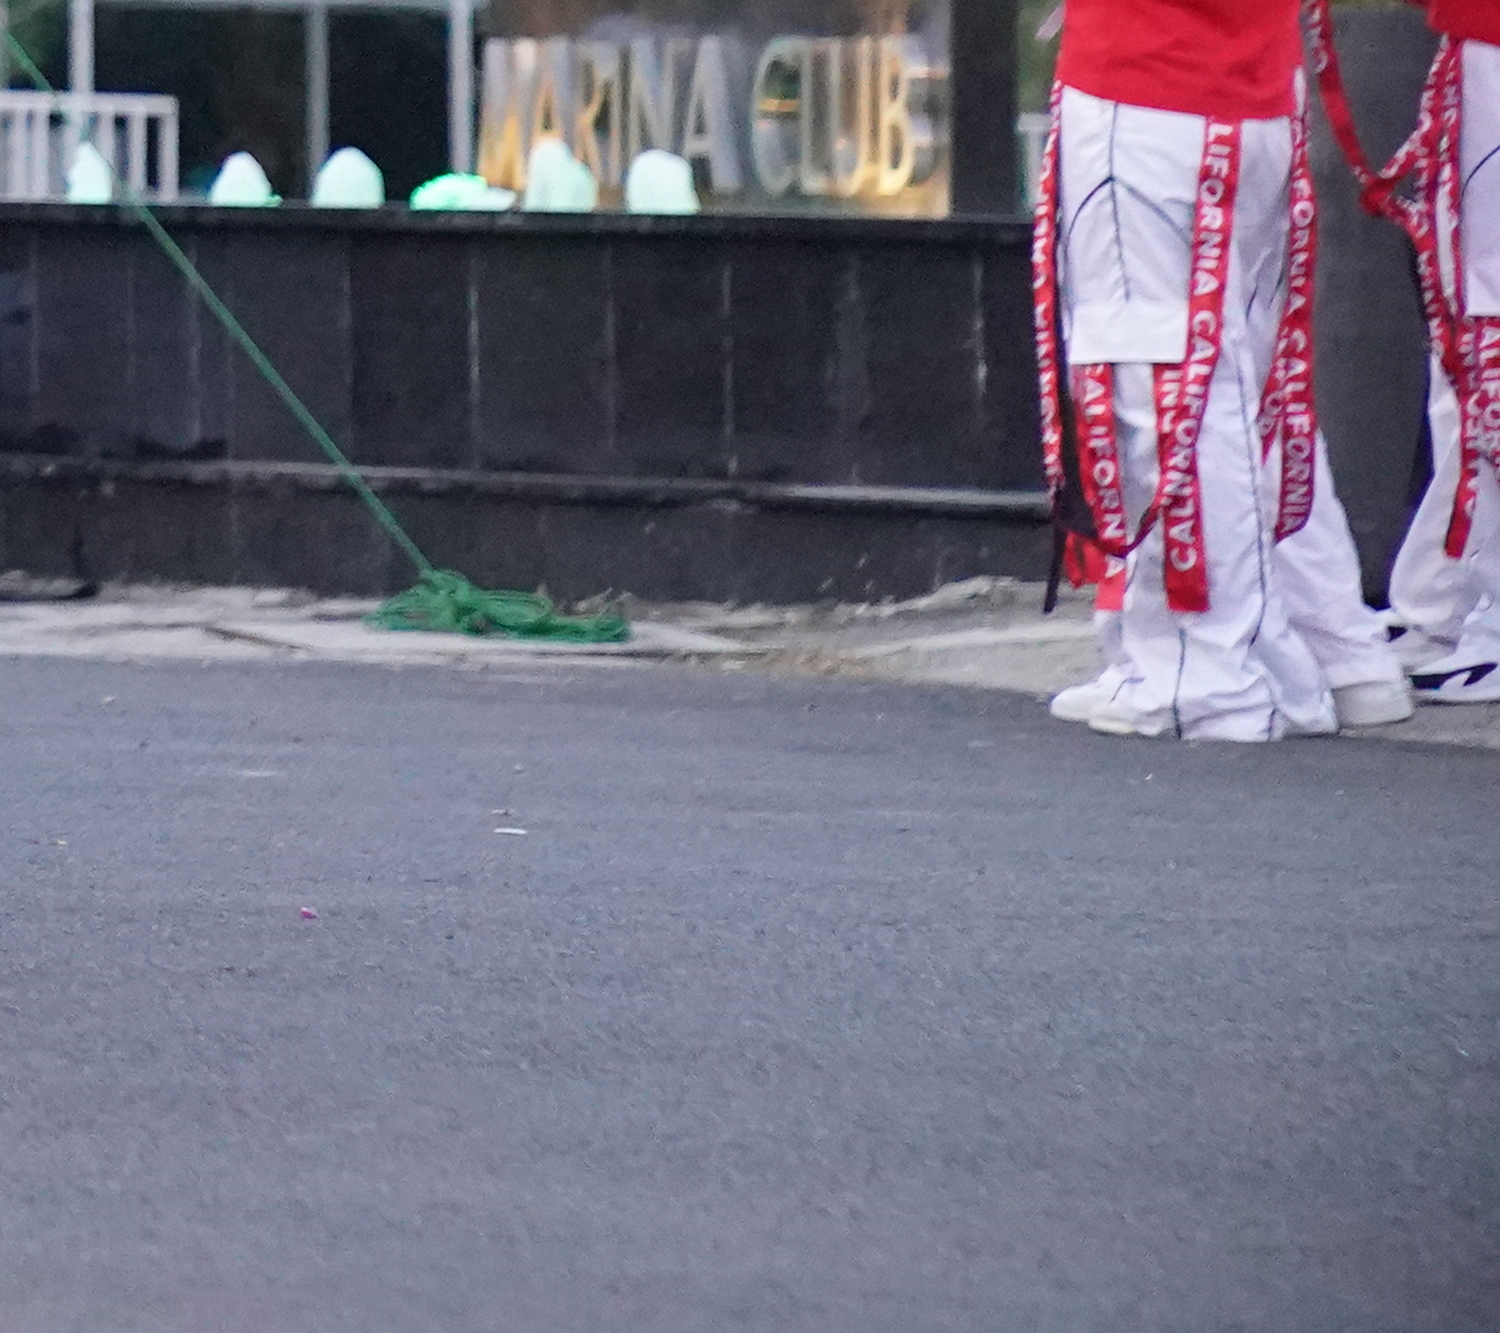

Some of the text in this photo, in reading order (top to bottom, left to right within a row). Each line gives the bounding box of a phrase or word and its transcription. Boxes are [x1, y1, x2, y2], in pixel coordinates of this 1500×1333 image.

[750, 33, 916, 197] CLUB
[1193, 123, 1235, 296] LIFORNIA
[1082, 363, 1126, 580] ALIFORNA
